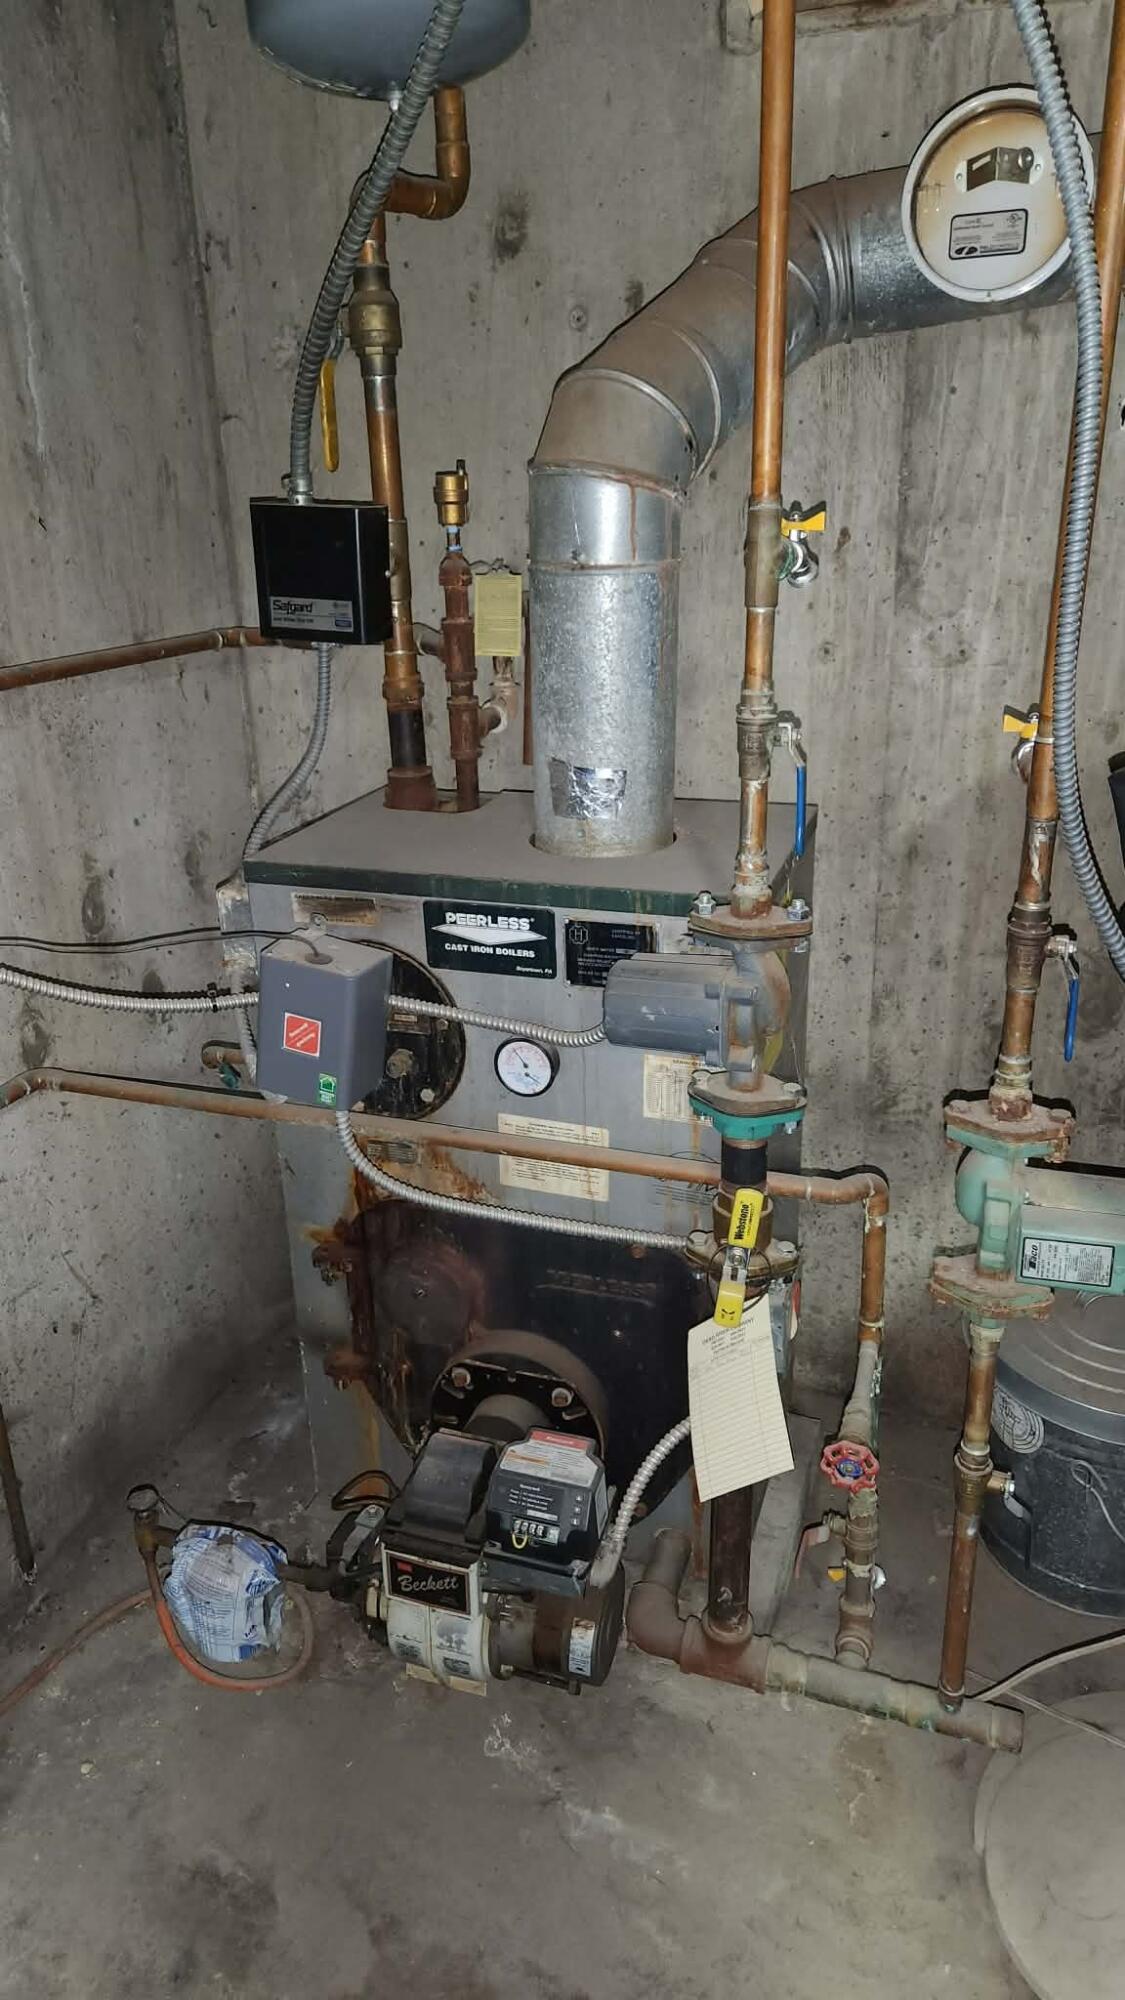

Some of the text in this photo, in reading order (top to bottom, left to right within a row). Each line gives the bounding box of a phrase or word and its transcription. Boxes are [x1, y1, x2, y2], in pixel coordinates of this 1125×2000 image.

[273, 600, 313, 614] Safgard
[444, 912, 530, 930] PEERLESS
[444, 942, 535, 958] CAST IRON BOILERS
[1028, 1244, 1039, 1269] Taco
[397, 1575, 459, 1592] Beckett
